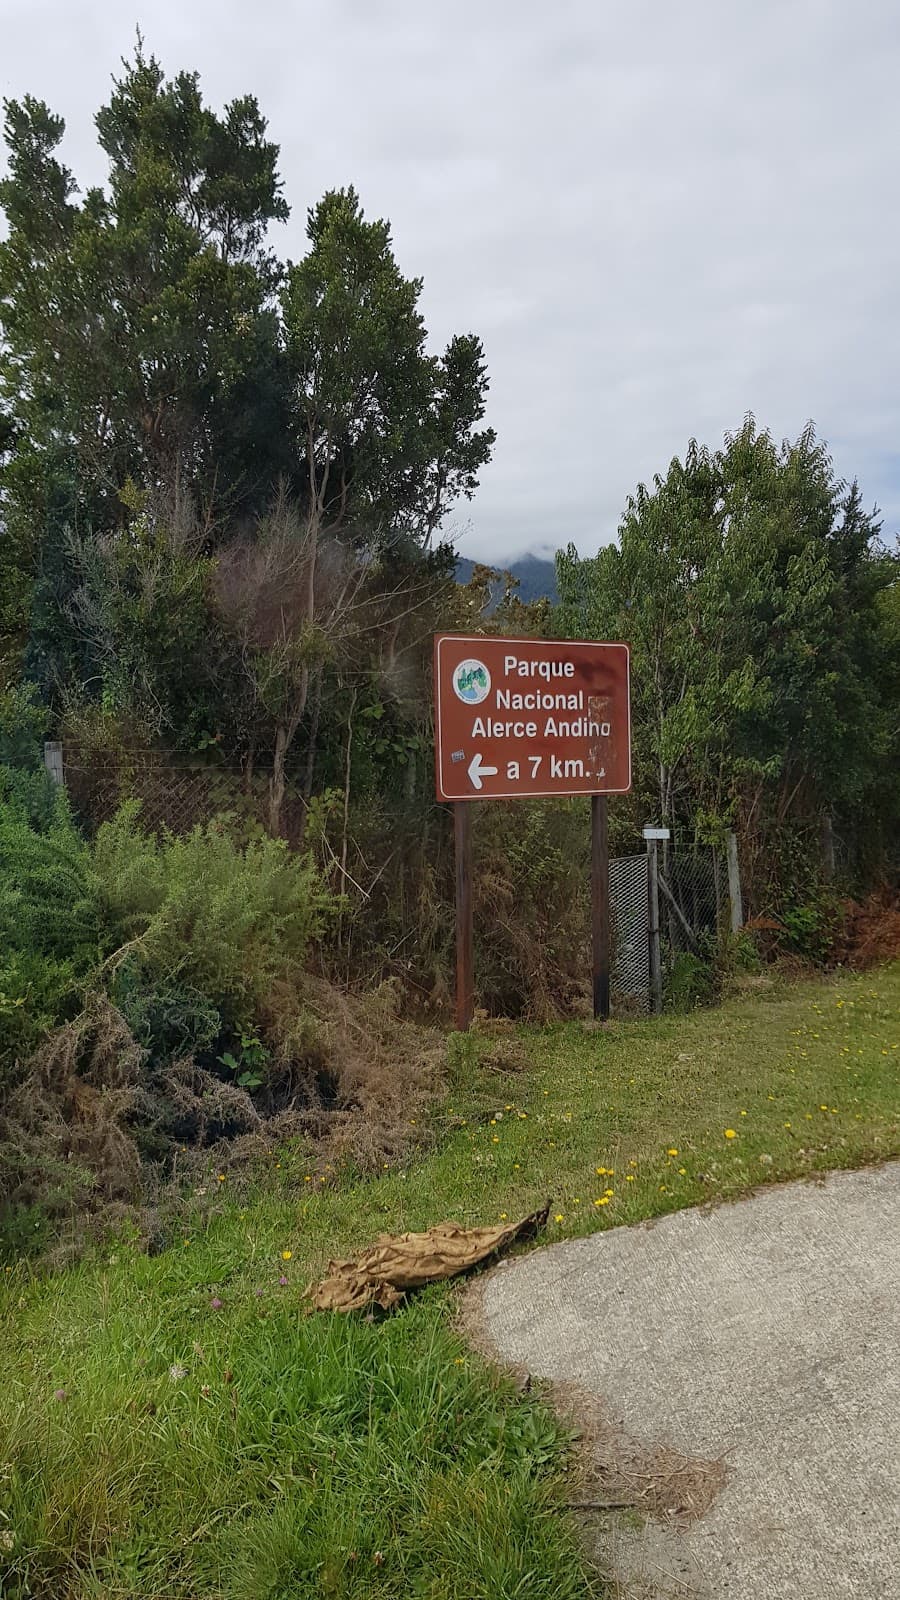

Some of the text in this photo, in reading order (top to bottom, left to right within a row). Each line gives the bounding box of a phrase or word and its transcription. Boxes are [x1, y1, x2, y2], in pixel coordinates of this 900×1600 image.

[503, 655, 575, 682] Parque
[496, 689, 584, 710] Nacional
[471, 717, 611, 738] Alerce Andino
[506, 755, 591, 780] a 7 km.
